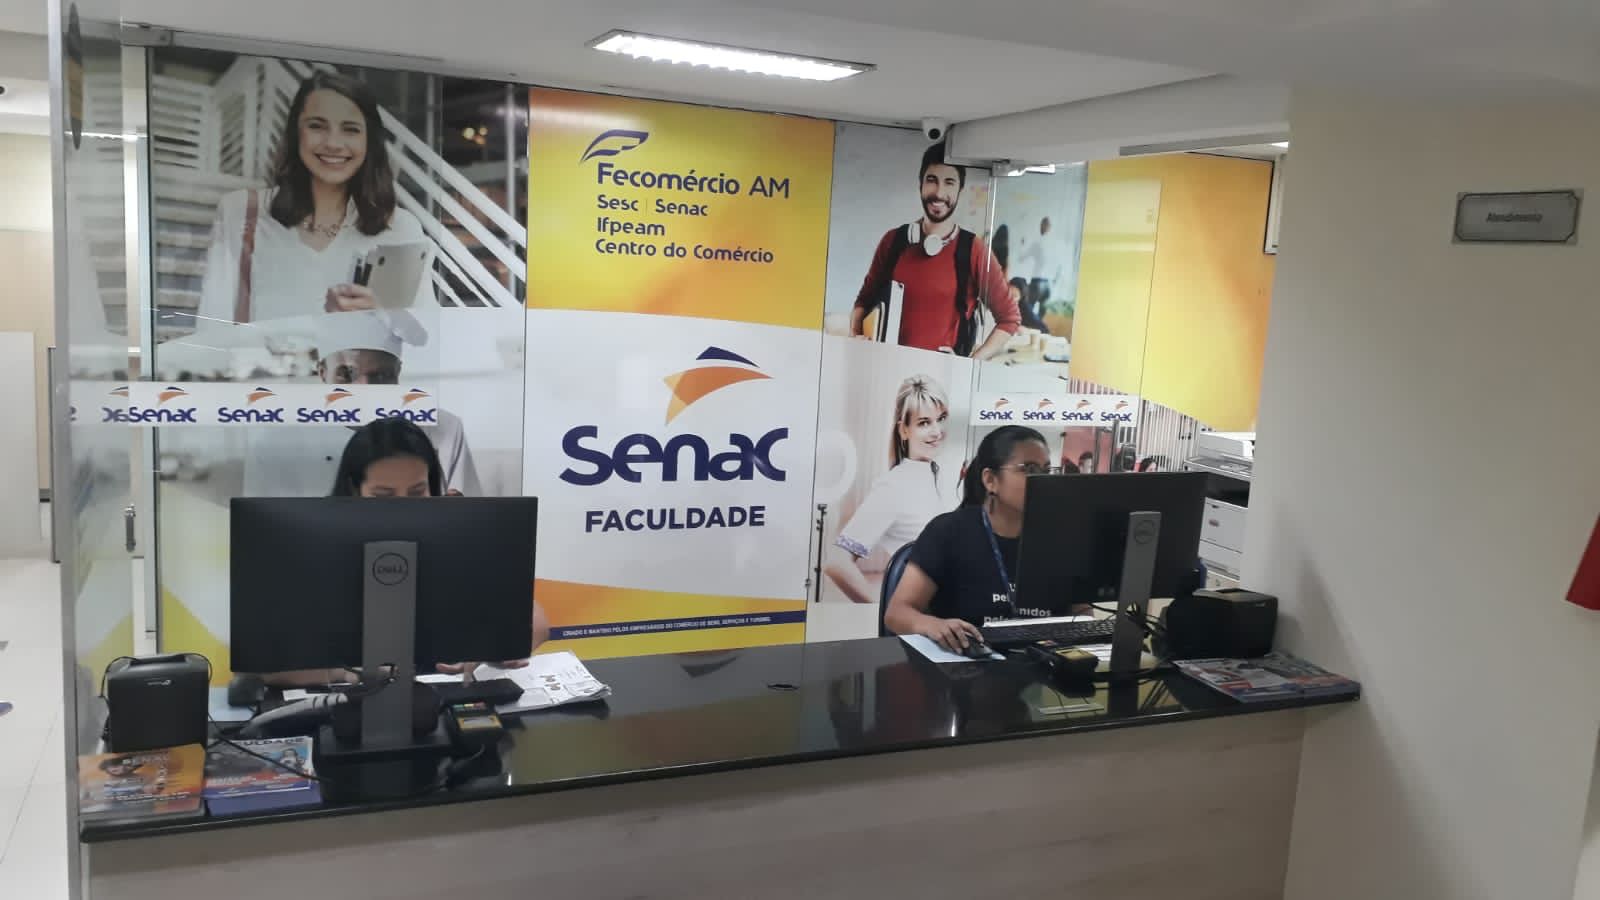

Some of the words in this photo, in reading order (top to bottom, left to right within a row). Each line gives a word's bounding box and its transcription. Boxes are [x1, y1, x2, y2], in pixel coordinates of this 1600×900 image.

[597, 162, 741, 195] Fecomércio
[749, 175, 790, 198] AM
[597, 195, 639, 211] Sesc
[655, 199, 708, 216] Senac
[597, 217, 665, 236] Ifpeam
[595, 239, 657, 257] Centro
[663, 243, 687, 258] do
[693, 244, 774, 263] Comércio
[129, 406, 197, 423] Senac
[218, 407, 284, 423] Senac
[297, 407, 361, 423] Senac
[979, 410, 1013, 420] Senac
[1023, 410, 1056, 421] Senac
[1062, 411, 1094, 421] Senac
[559, 425, 789, 486] Senac
[585, 505, 766, 533] FACULDADE
